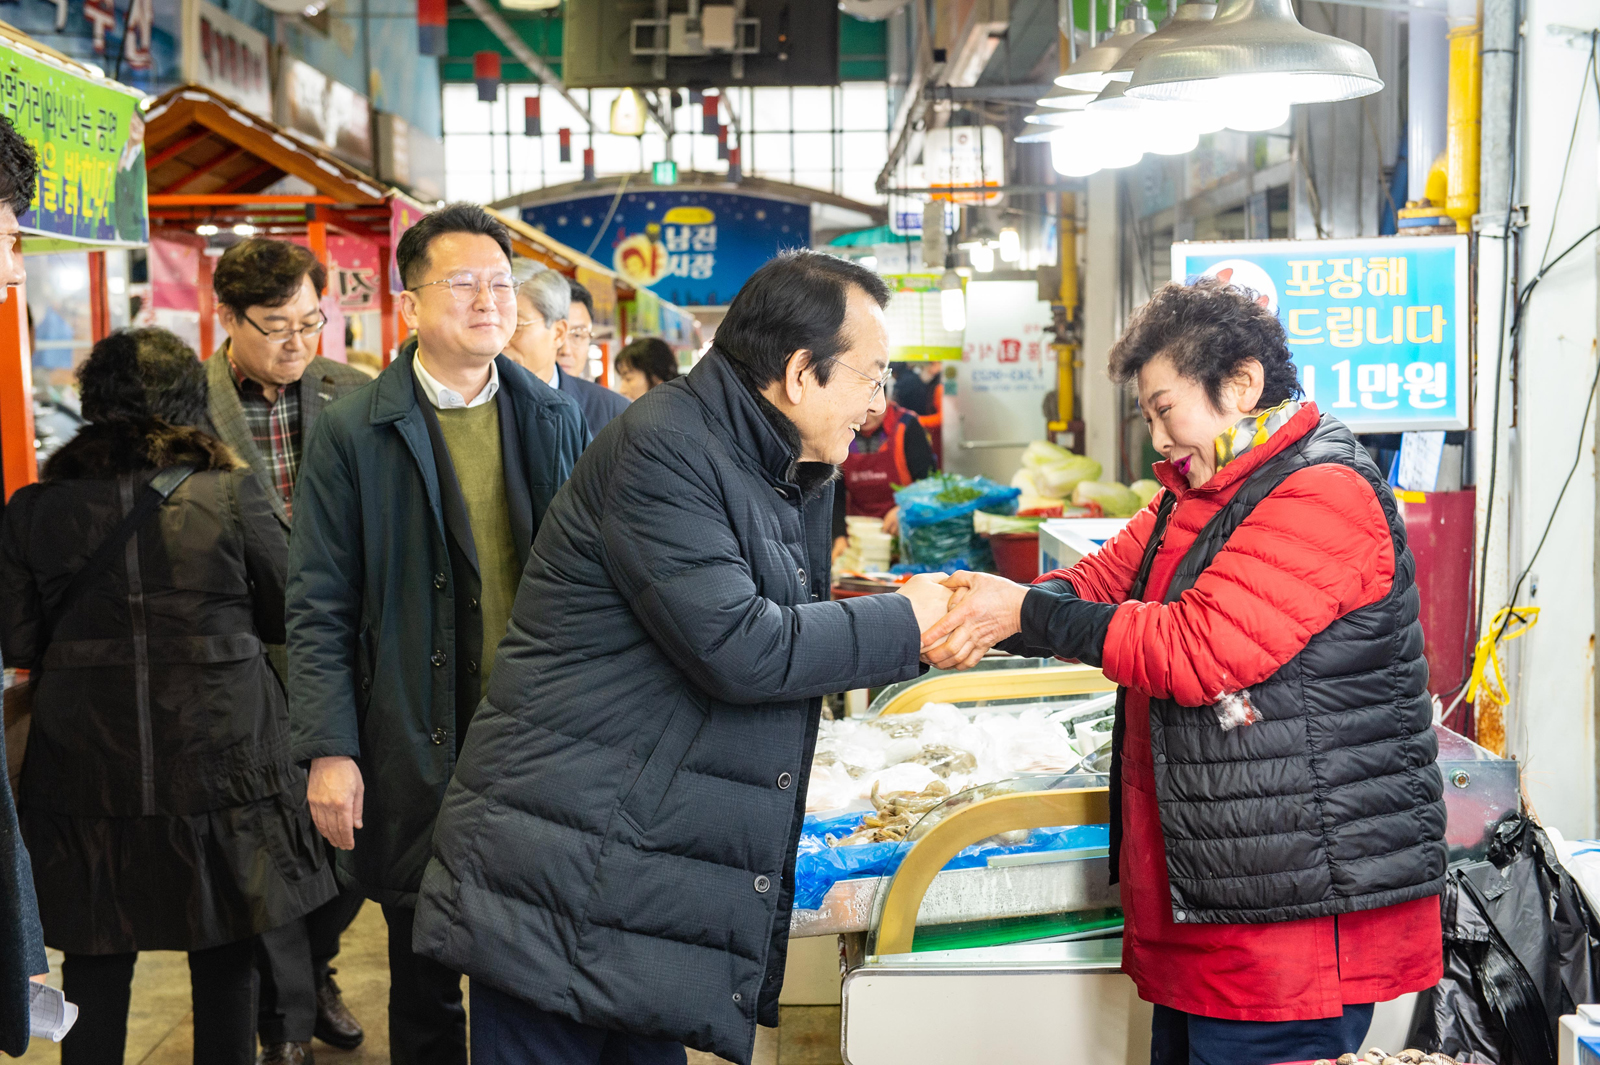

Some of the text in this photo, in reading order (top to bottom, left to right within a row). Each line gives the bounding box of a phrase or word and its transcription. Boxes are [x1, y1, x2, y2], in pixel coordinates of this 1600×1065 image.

[1285, 257, 1408, 299] 포장해
[1287, 304, 1448, 348] 드립니다
[1331, 359, 1448, 410] 1만원
